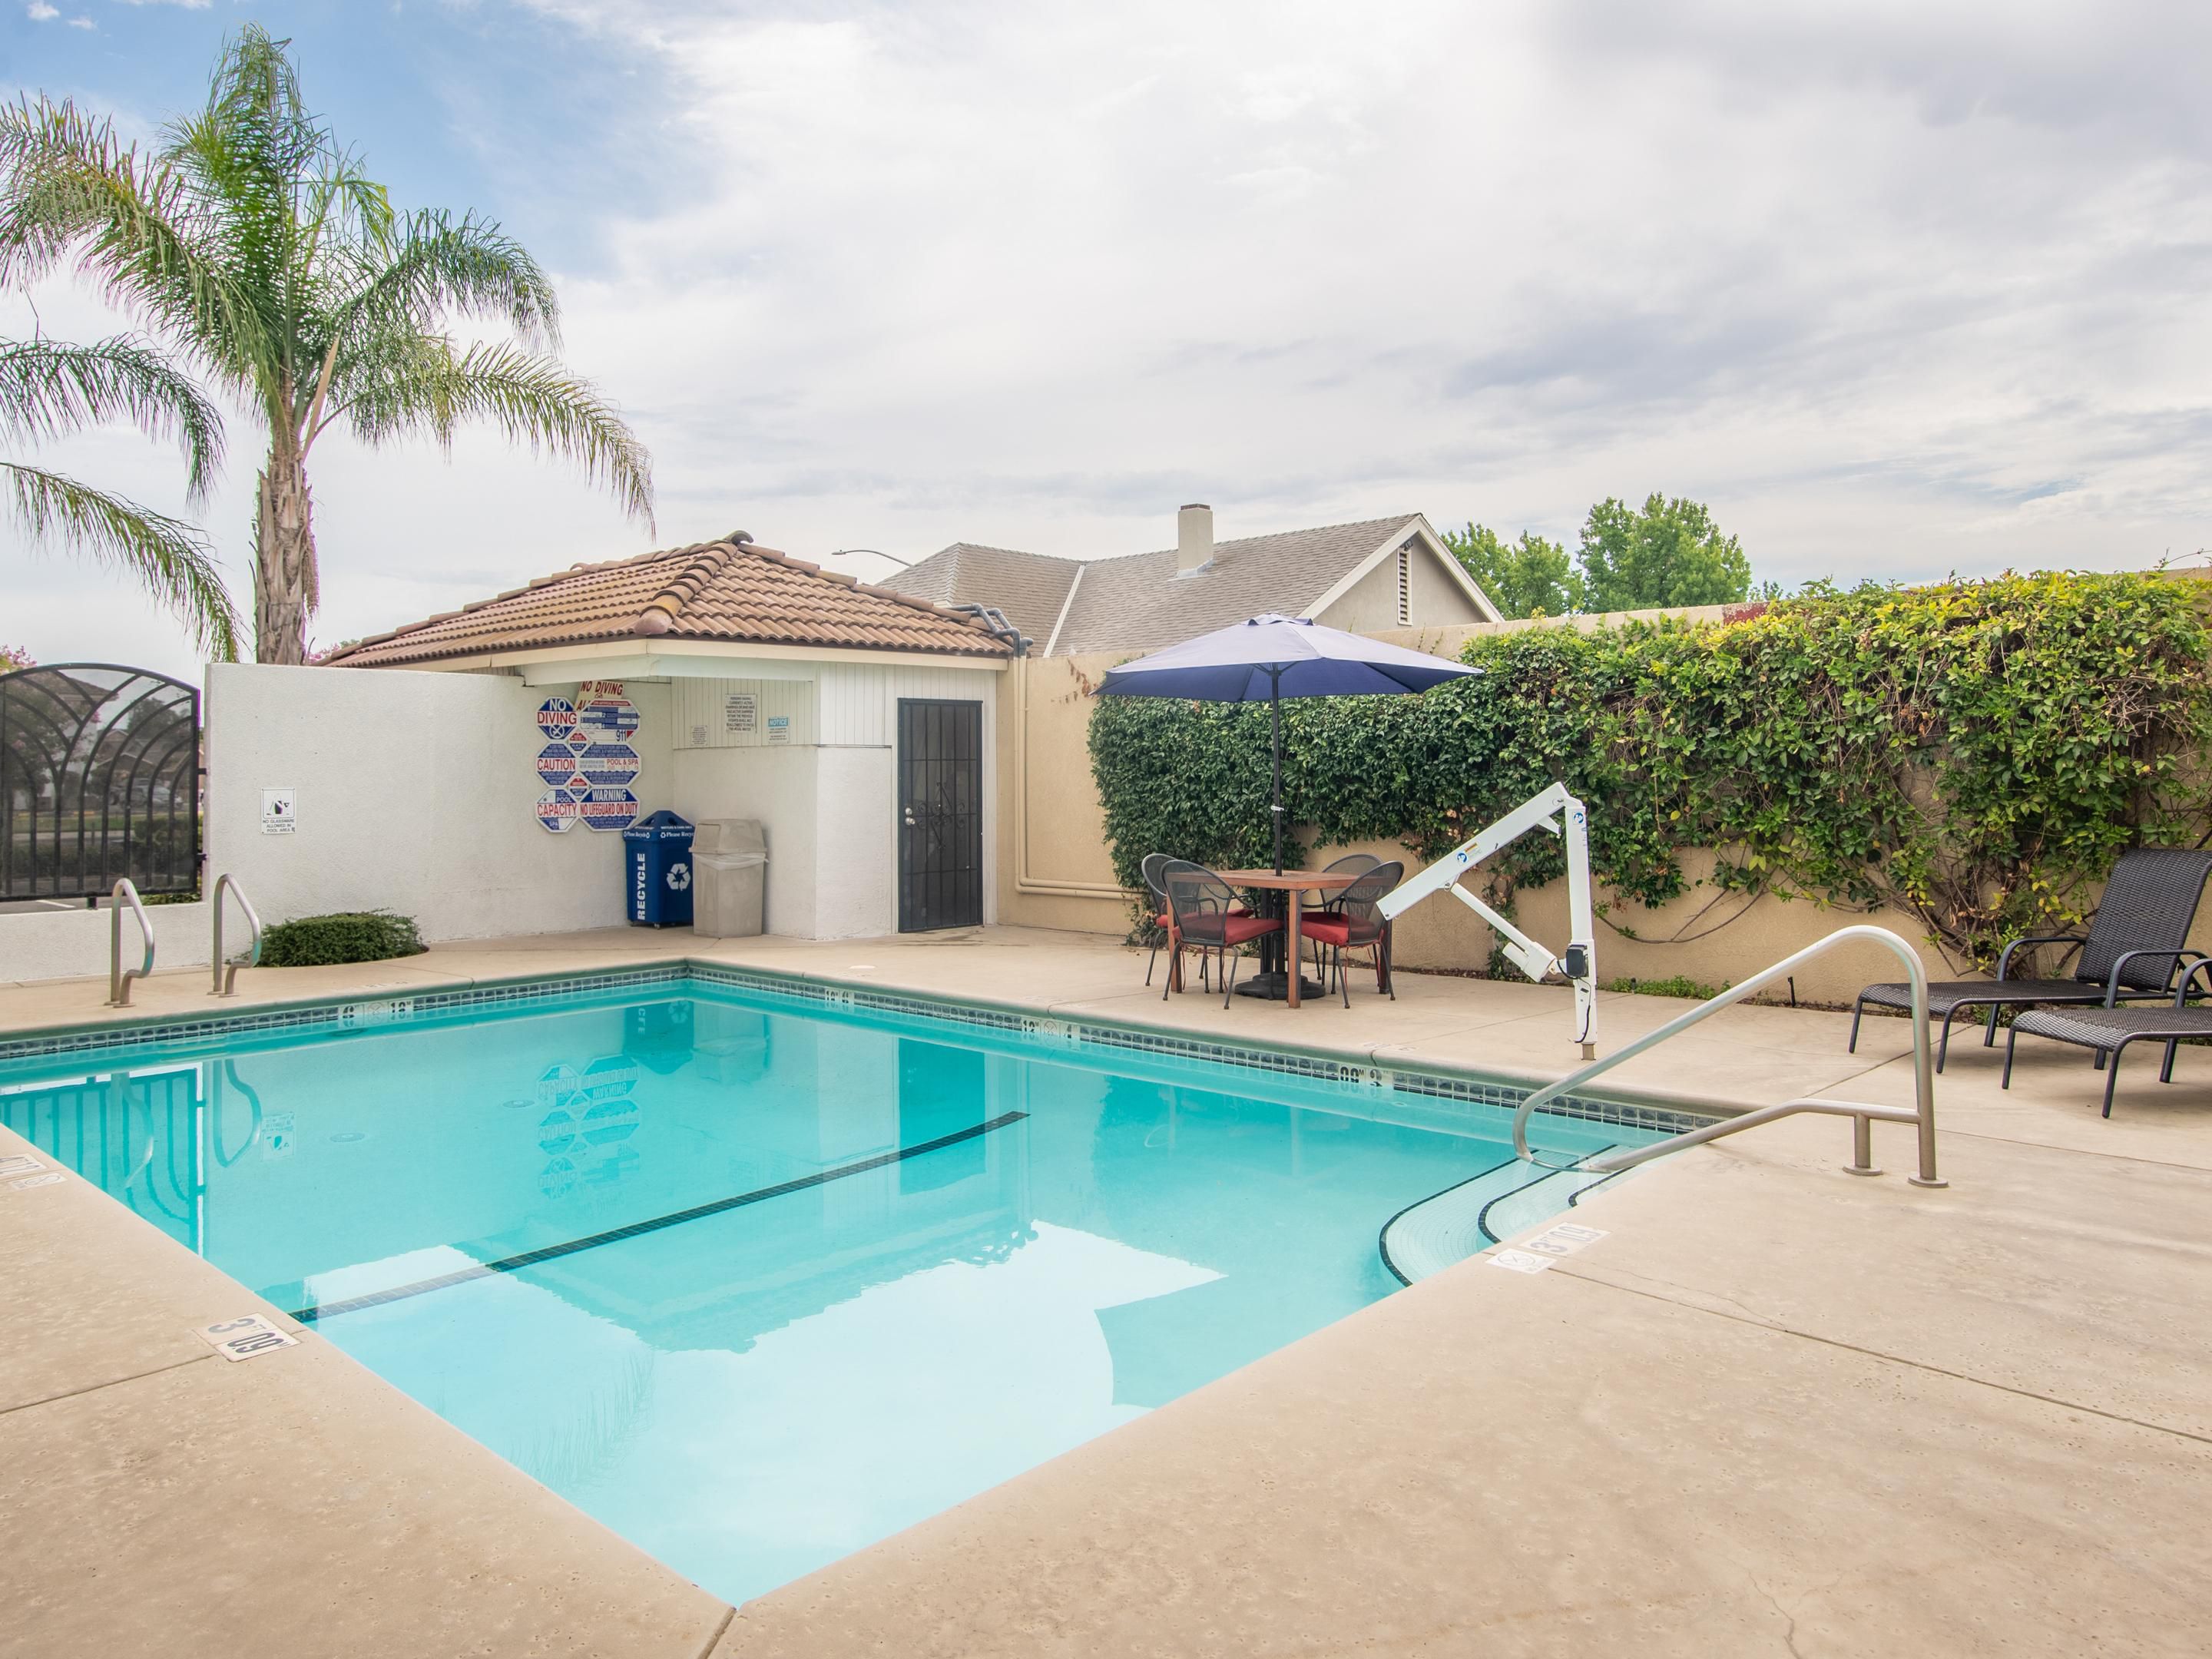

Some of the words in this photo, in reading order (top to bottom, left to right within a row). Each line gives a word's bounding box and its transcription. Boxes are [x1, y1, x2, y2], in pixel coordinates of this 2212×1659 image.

[580, 681, 592, 692] NO
[595, 681, 624, 696] DIVING
[549, 699, 566, 711] NO
[537, 712, 577, 724] DIVING
[616, 730, 627, 742] 911
[537, 759, 575, 770] CAUTION
[591, 789, 627, 801] WARNING
[537, 804, 577, 816] CAPACITY
[580, 804, 588, 815] NO
[589, 803, 614, 815] LIFEGUARD
[616, 803, 624, 814] ON
[625, 803, 638, 814] DUTY
[637, 853, 645, 920] RECYCLE
[1530, 1241, 1568, 1252] 3
[208, 1318, 256, 1333] 3
